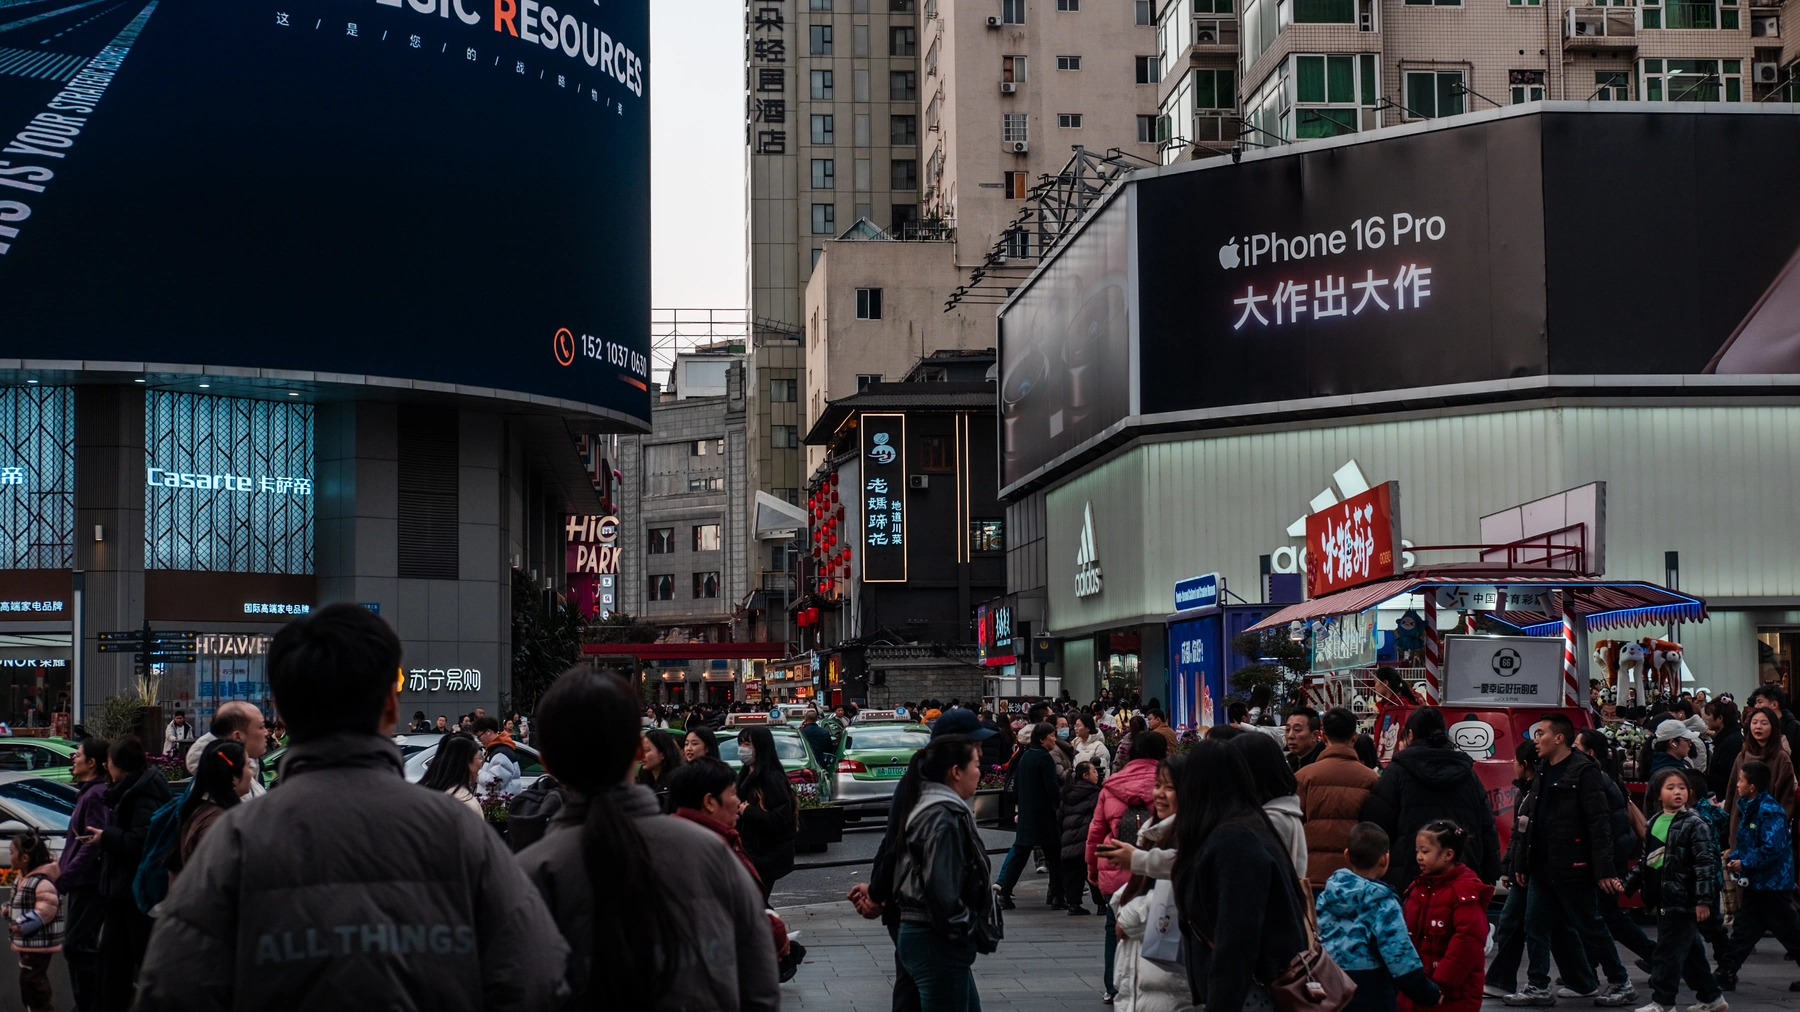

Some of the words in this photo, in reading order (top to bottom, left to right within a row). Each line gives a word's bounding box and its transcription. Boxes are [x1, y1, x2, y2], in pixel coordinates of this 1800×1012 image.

[494, 0, 642, 98] RESOURCES
[754, 0, 786, 154] 朵轻居酒店
[3, 112, 87, 158] YOUR
[1244, 230, 1346, 267] iPhone
[1351, 216, 1386, 250] 16
[1393, 212, 1446, 246] Pro
[1233, 263, 1432, 330] 大作出大作
[581, 334, 603, 360] 152
[606, 341, 628, 368] 1037
[631, 350, 647, 378] 0630
[147, 467, 252, 492] Casarte
[258, 476, 311, 496] 卡萨帝
[891, 500, 902, 545] 地道川菜
[576, 545, 622, 574] PARK
[1074, 561, 1103, 598] adidas
[244, 603, 310, 615] 国际高端家电品牌
[0, 659, 36, 668] NOR
[196, 637, 274, 655] HUAWE
[1502, 658, 1511, 667] 66
[409, 668, 481, 691] 苏宁易购
[255, 928, 328, 965] ALL
[333, 923, 473, 956] THINGS
